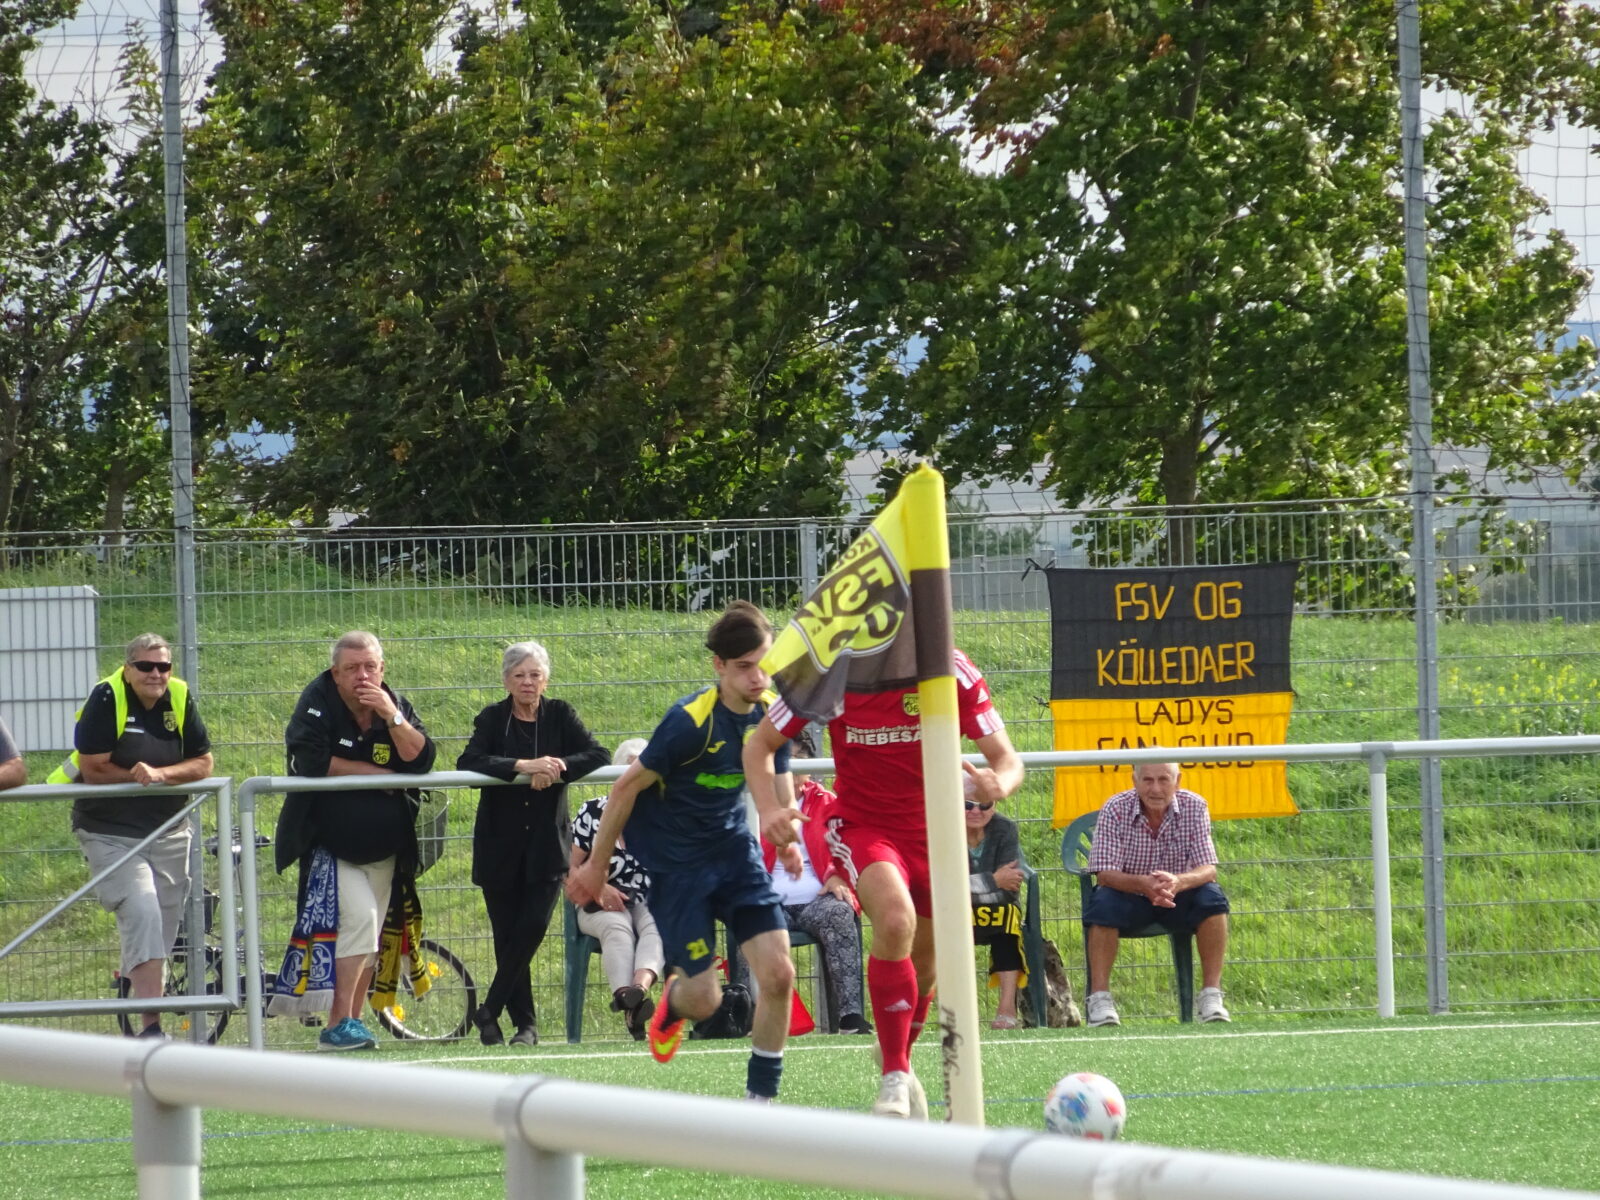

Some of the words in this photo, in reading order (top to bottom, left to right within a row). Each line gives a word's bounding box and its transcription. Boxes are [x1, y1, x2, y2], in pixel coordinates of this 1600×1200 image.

[1115, 581, 1175, 621] FSV
[1096, 638, 1256, 687] KÖLLEDAER
[1135, 698, 1234, 726] LADYS
[846, 730, 923, 746] RIEBESA
